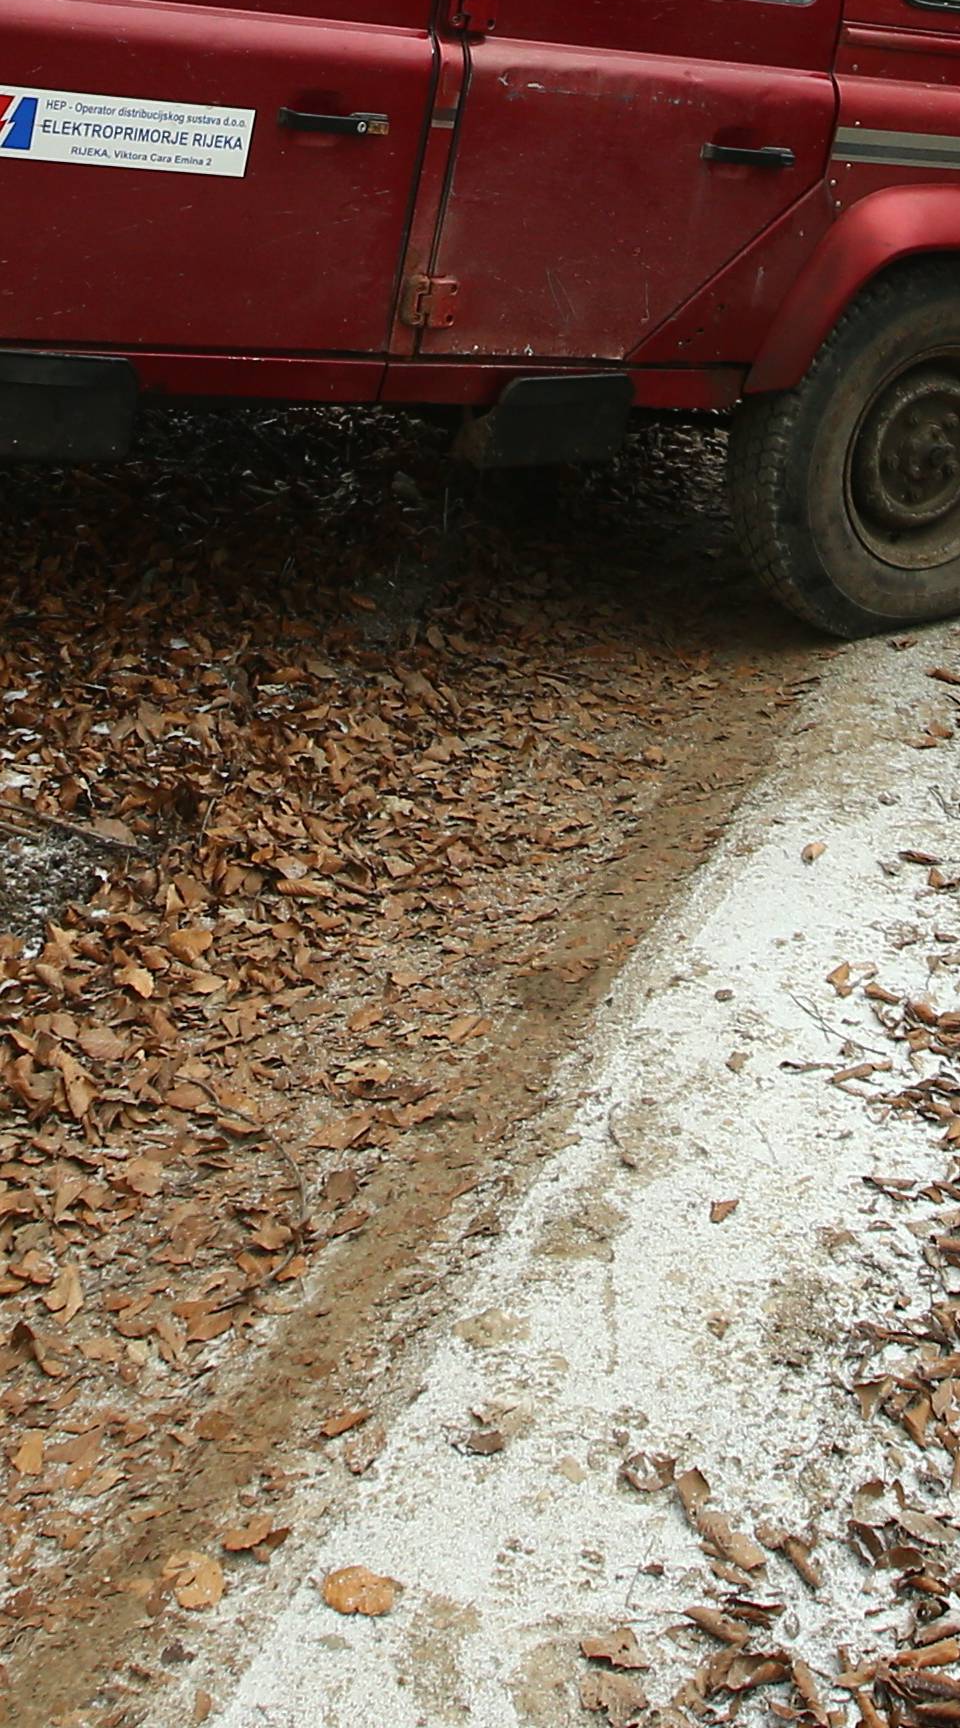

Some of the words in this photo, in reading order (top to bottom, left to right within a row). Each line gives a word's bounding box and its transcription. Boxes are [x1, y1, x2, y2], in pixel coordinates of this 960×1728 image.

[46, 99, 67, 111] HEP
[75, 102, 116, 116] Operator
[118, 107, 185, 124] distribucijskog
[186, 114, 221, 126] sustava
[223, 116, 247, 128] d.o.o.
[42, 119, 189, 146] ELEKTROPRIMORJE
[192, 133, 243, 151] RIJEKA
[71, 146, 111, 159] RIJEKA,
[114, 150, 147, 161] Viktora
[150, 153, 172, 164] Cara
[174, 155, 204, 166] Emina
[205, 158, 212, 166] 2
